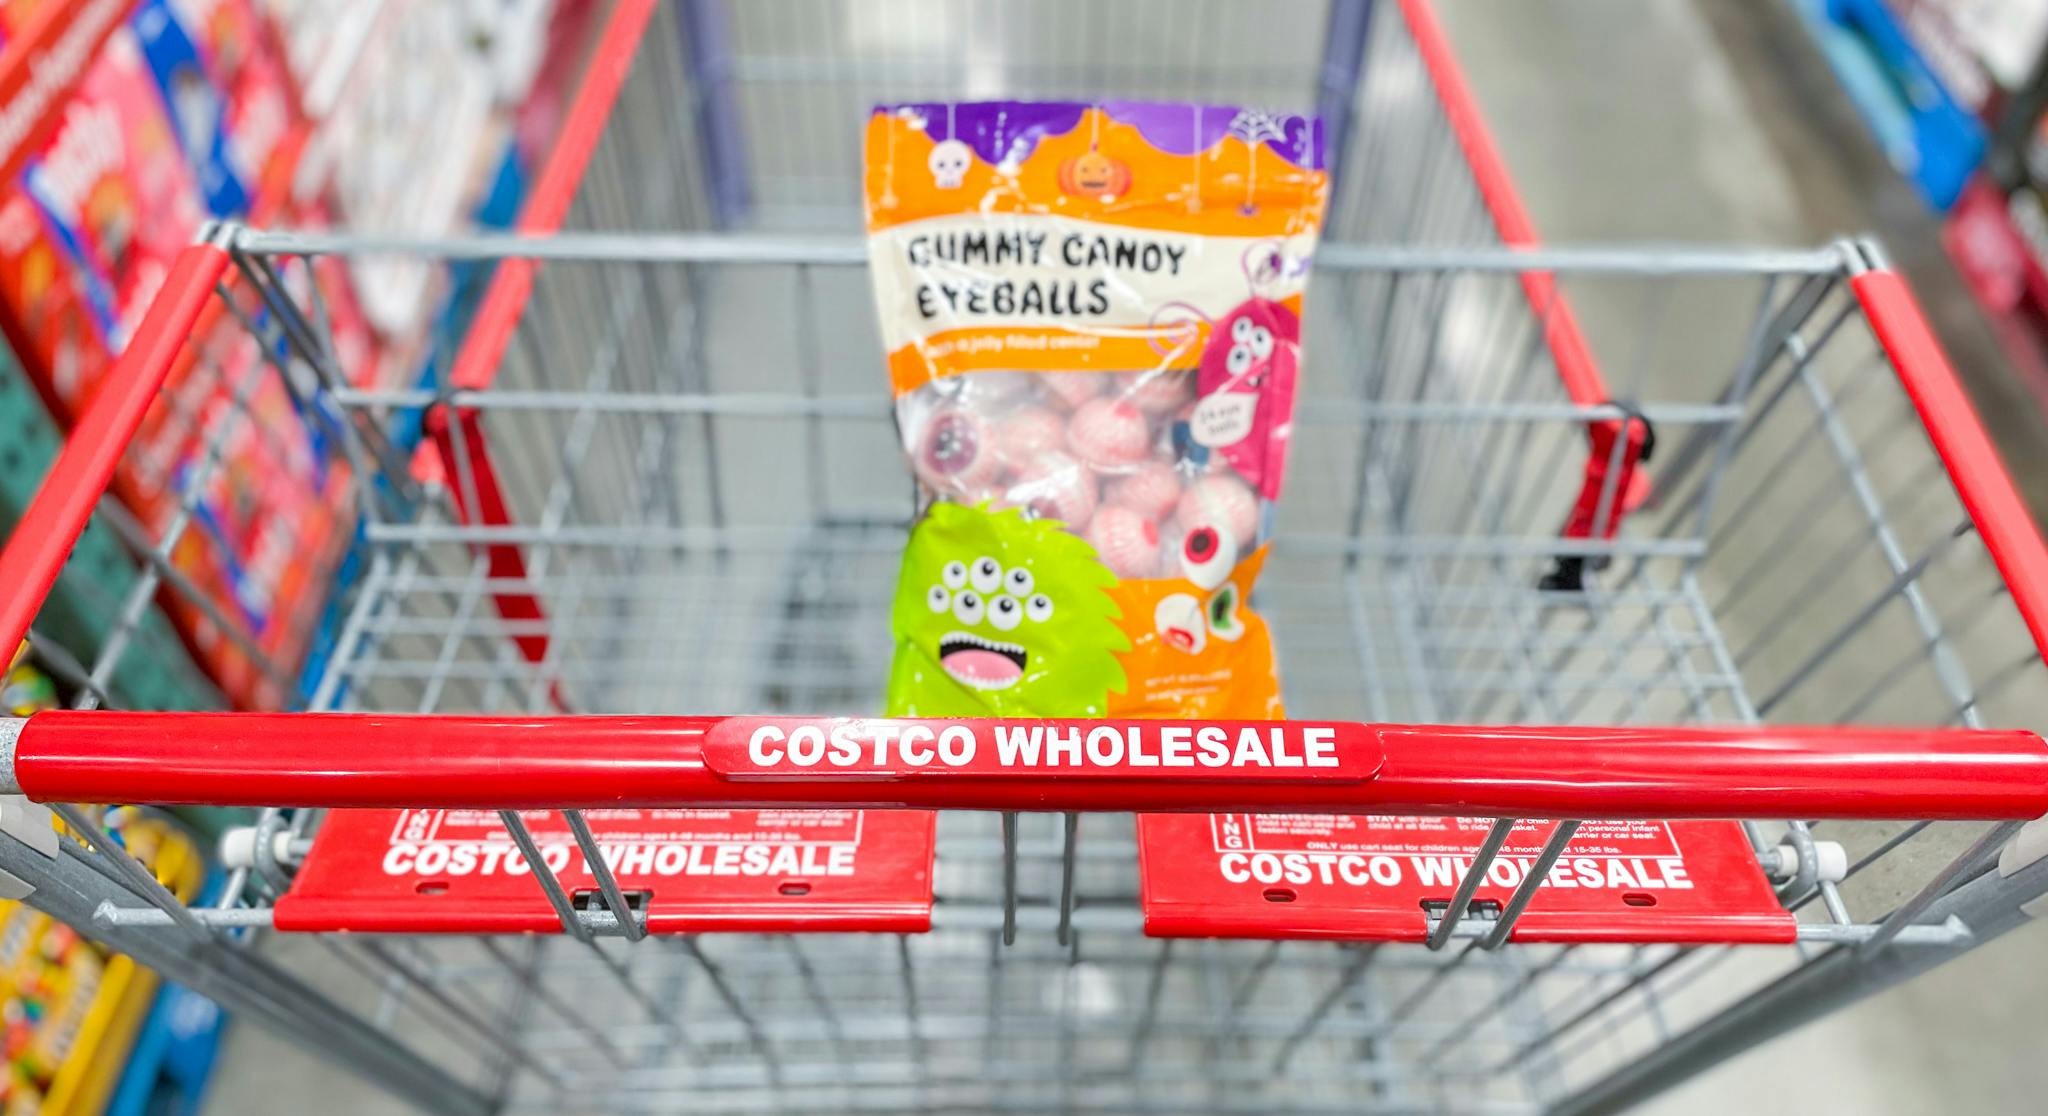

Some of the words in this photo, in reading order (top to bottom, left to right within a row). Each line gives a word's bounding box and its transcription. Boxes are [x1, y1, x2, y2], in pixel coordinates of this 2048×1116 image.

[908, 231, 1046, 267] GUMMY
[1062, 233, 1186, 275] CANDY
[917, 281, 1110, 318] EYEBALLS
[748, 725, 977, 767] COSTCO
[995, 726, 1341, 767] WHOLESALE
[1588, 825, 1631, 833] personal
[382, 843, 570, 876] COSTCO
[583, 844, 857, 876] WHOLESALE
[1306, 841, 1338, 850] ONLY
[1420, 844, 1460, 852] children
[1220, 852, 1401, 885] COSTCO
